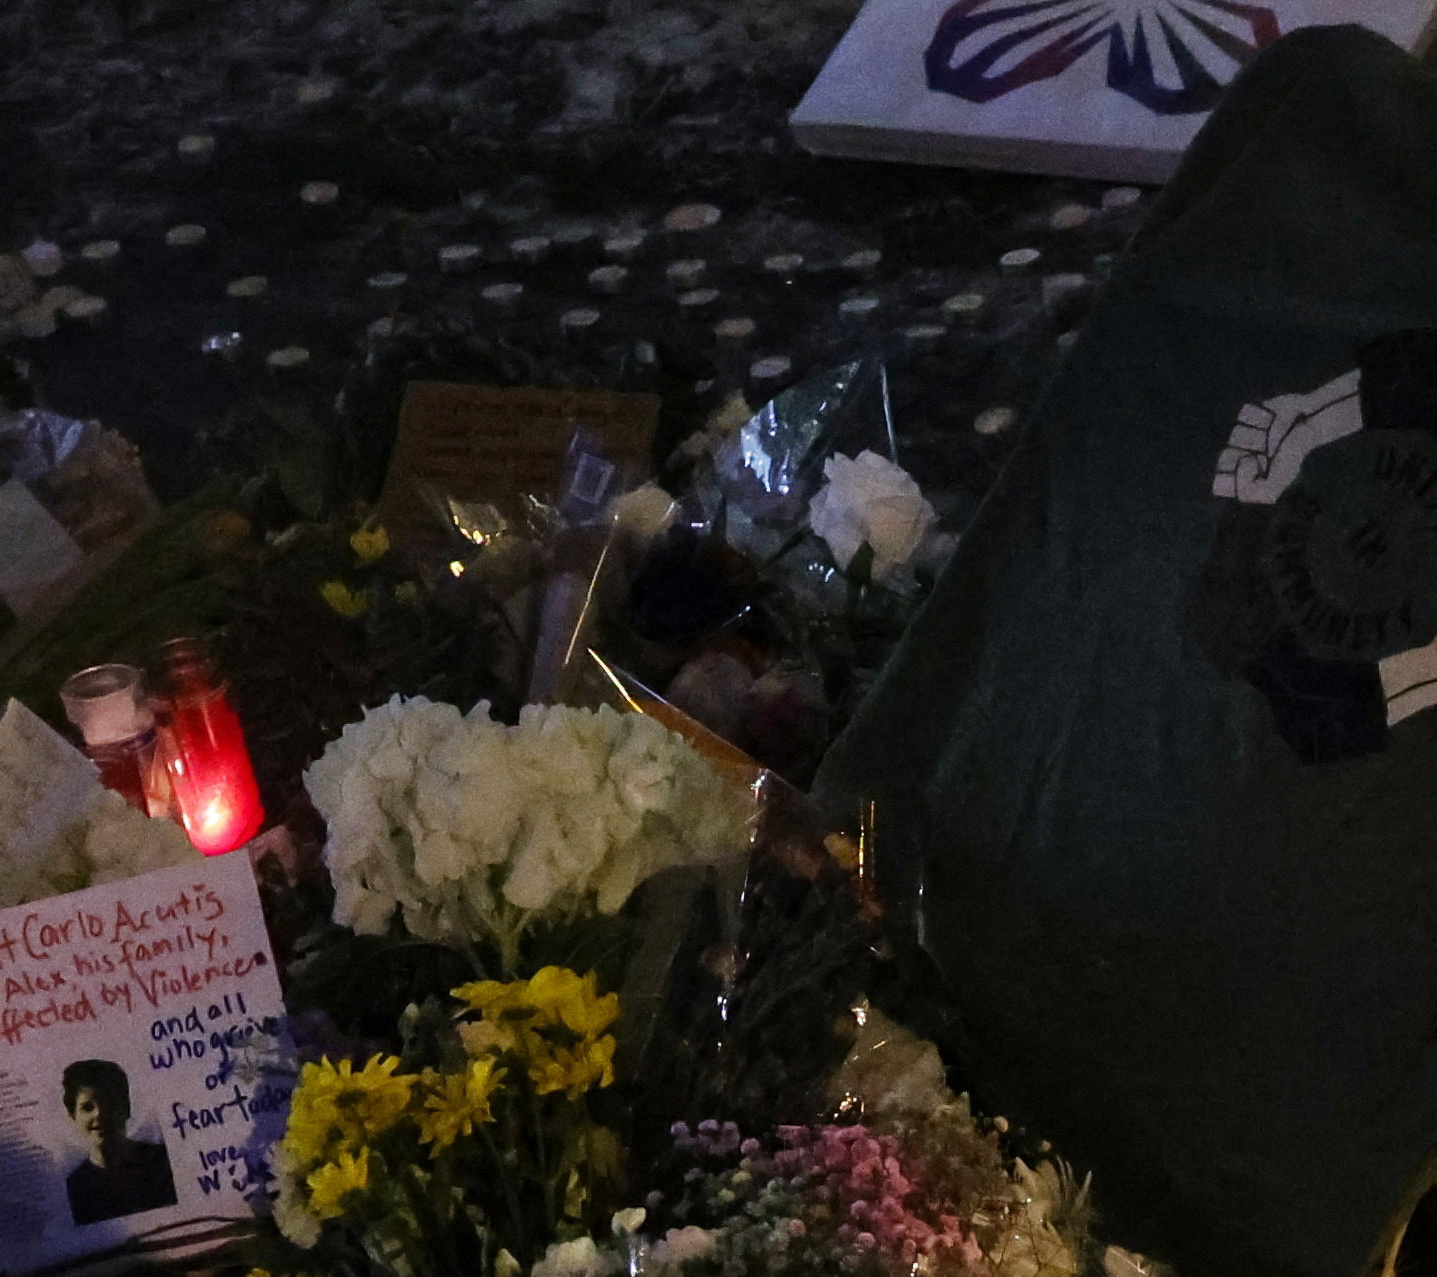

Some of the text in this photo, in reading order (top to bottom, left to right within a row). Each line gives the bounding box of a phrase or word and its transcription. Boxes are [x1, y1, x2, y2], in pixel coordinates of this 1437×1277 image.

[21, 909, 103, 959] Carlo
[111, 882, 225, 944] Acutis
[71, 950, 115, 976] his
[99, 982, 132, 1014] by
[150, 992, 247, 1046] and all
[148, 1035, 213, 1069] who
[171, 1099, 236, 1140] fear
